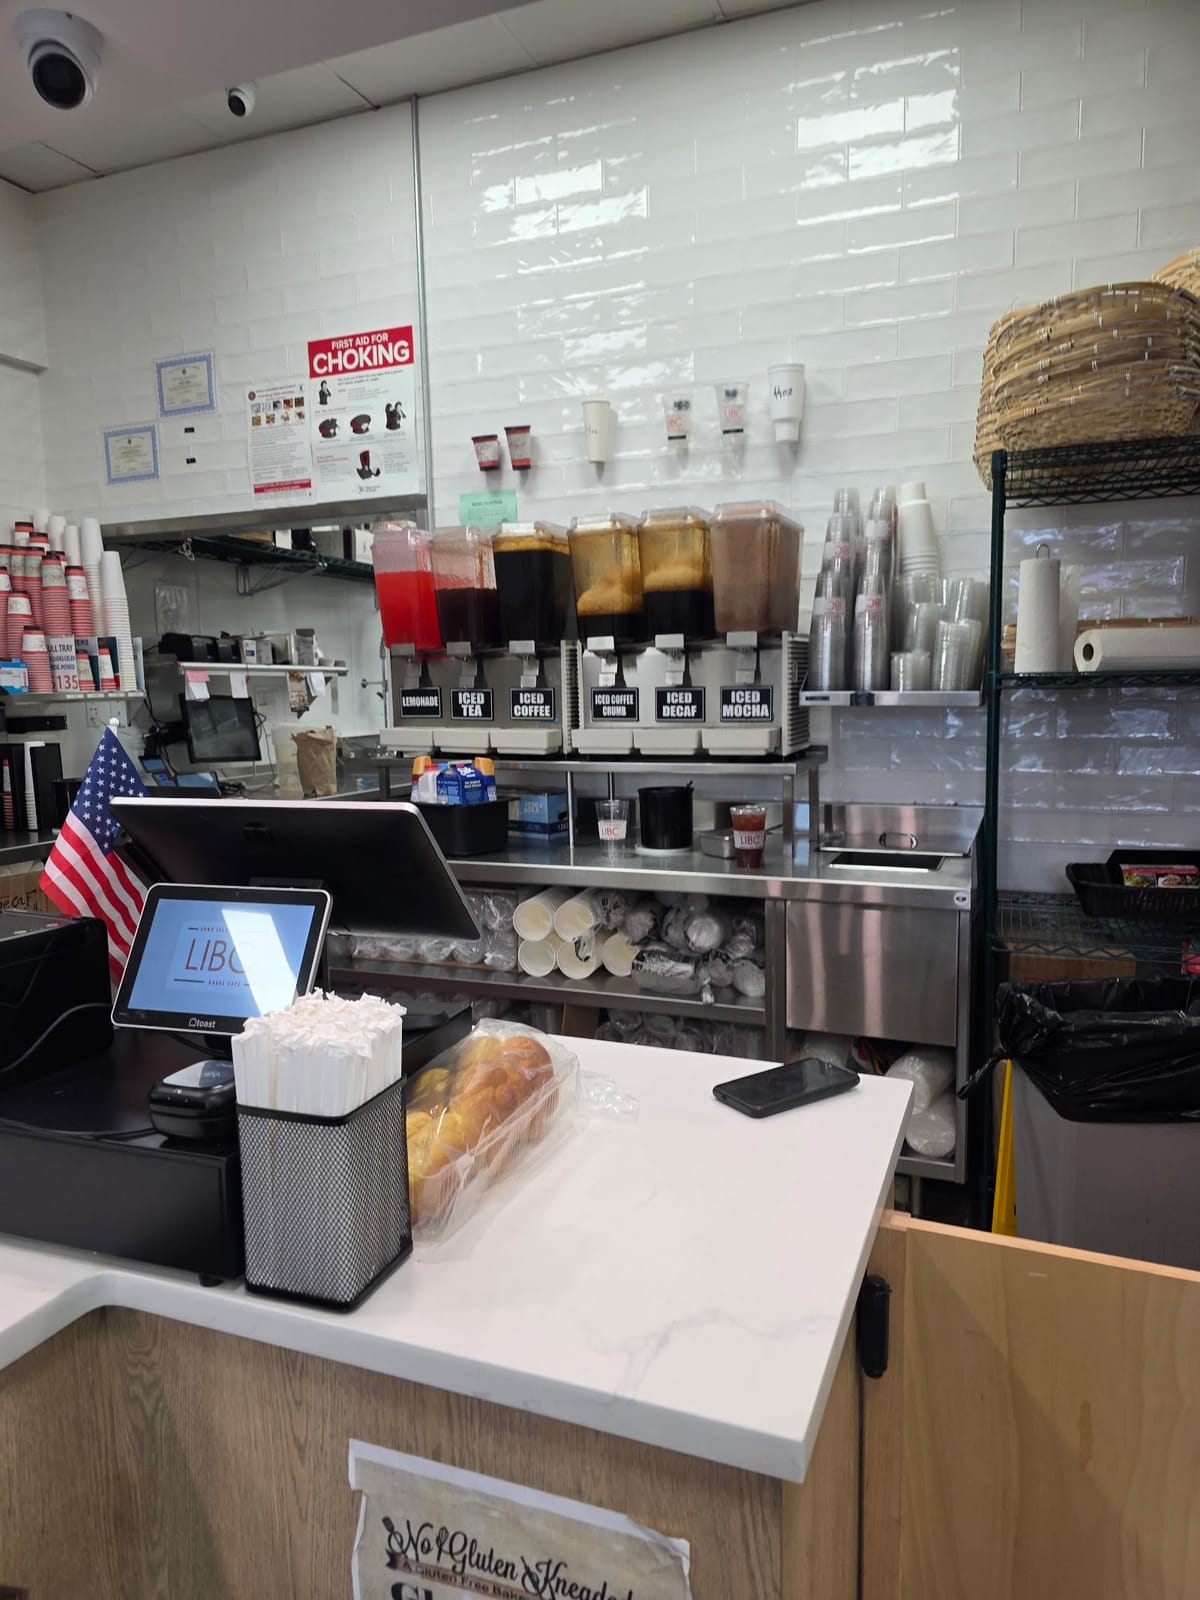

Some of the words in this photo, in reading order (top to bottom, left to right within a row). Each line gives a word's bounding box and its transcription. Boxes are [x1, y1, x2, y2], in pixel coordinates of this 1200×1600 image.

[331, 338, 354, 350] FIRST
[355, 335, 370, 346] AID
[371, 332, 389, 344] FOR
[312, 339, 410, 375] CHOKING
[47, 644, 58, 653] ULL
[59, 643, 73, 653] TRAY
[402, 695, 439, 708] LEMONADE
[458, 692, 485, 704] ICED
[519, 692, 544, 704] ICED
[595, 694, 610, 705] ICED
[611, 694, 634, 706] COFFEE
[666, 692, 692, 704] ICED
[731, 691, 760, 704] ICED
[461, 704, 483, 717] TEA
[513, 705, 551, 717] COFFEE
[602, 706, 627, 717] CRUMB
[662, 705, 697, 717] DECAF
[722, 704, 769, 718] MOCHA
[197, 1019, 216, 1029] toast
[388, 1519, 434, 1563] No
[441, 1529, 518, 1581] Gluten
[522, 1556, 634, 1600] Knead
[415, 1564, 458, 1584] Gluten
[460, 1575, 490, 1593] Free
